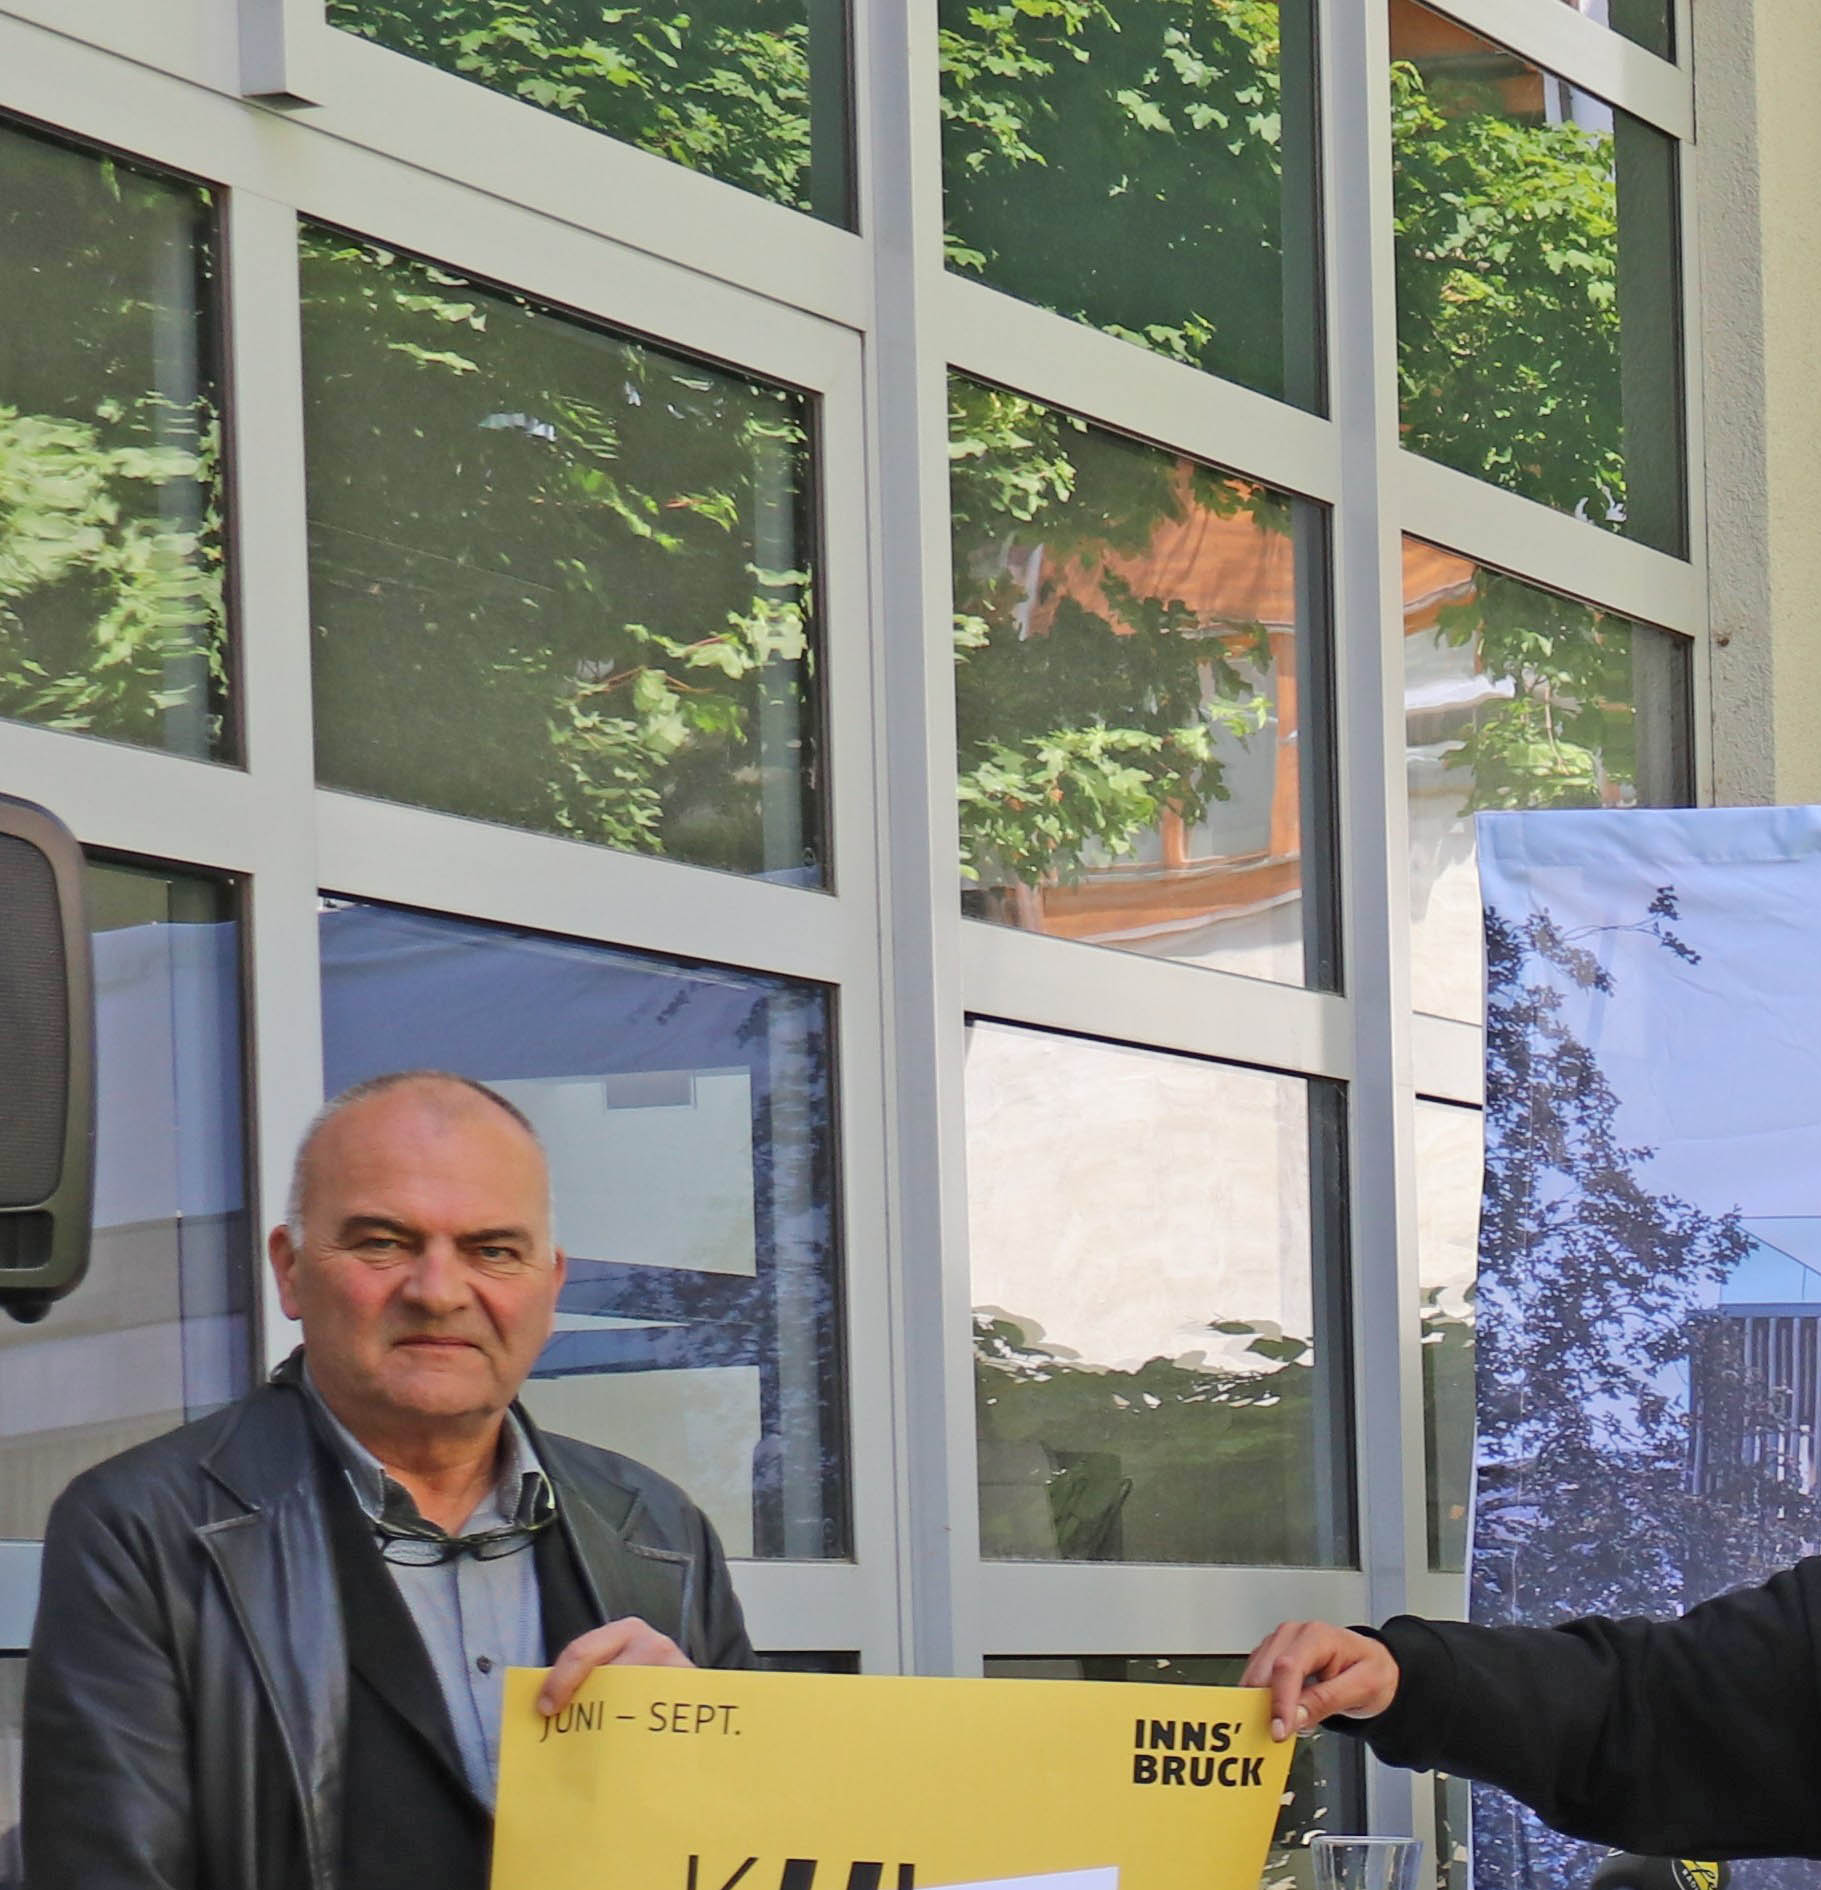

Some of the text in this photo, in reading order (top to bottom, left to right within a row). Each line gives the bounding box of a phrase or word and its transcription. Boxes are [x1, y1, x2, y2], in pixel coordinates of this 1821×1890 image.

[540, 1701, 604, 1743] JUNI
[648, 1701, 742, 1736] SEPT.
[1132, 1754, 1265, 1787] BRUCK
